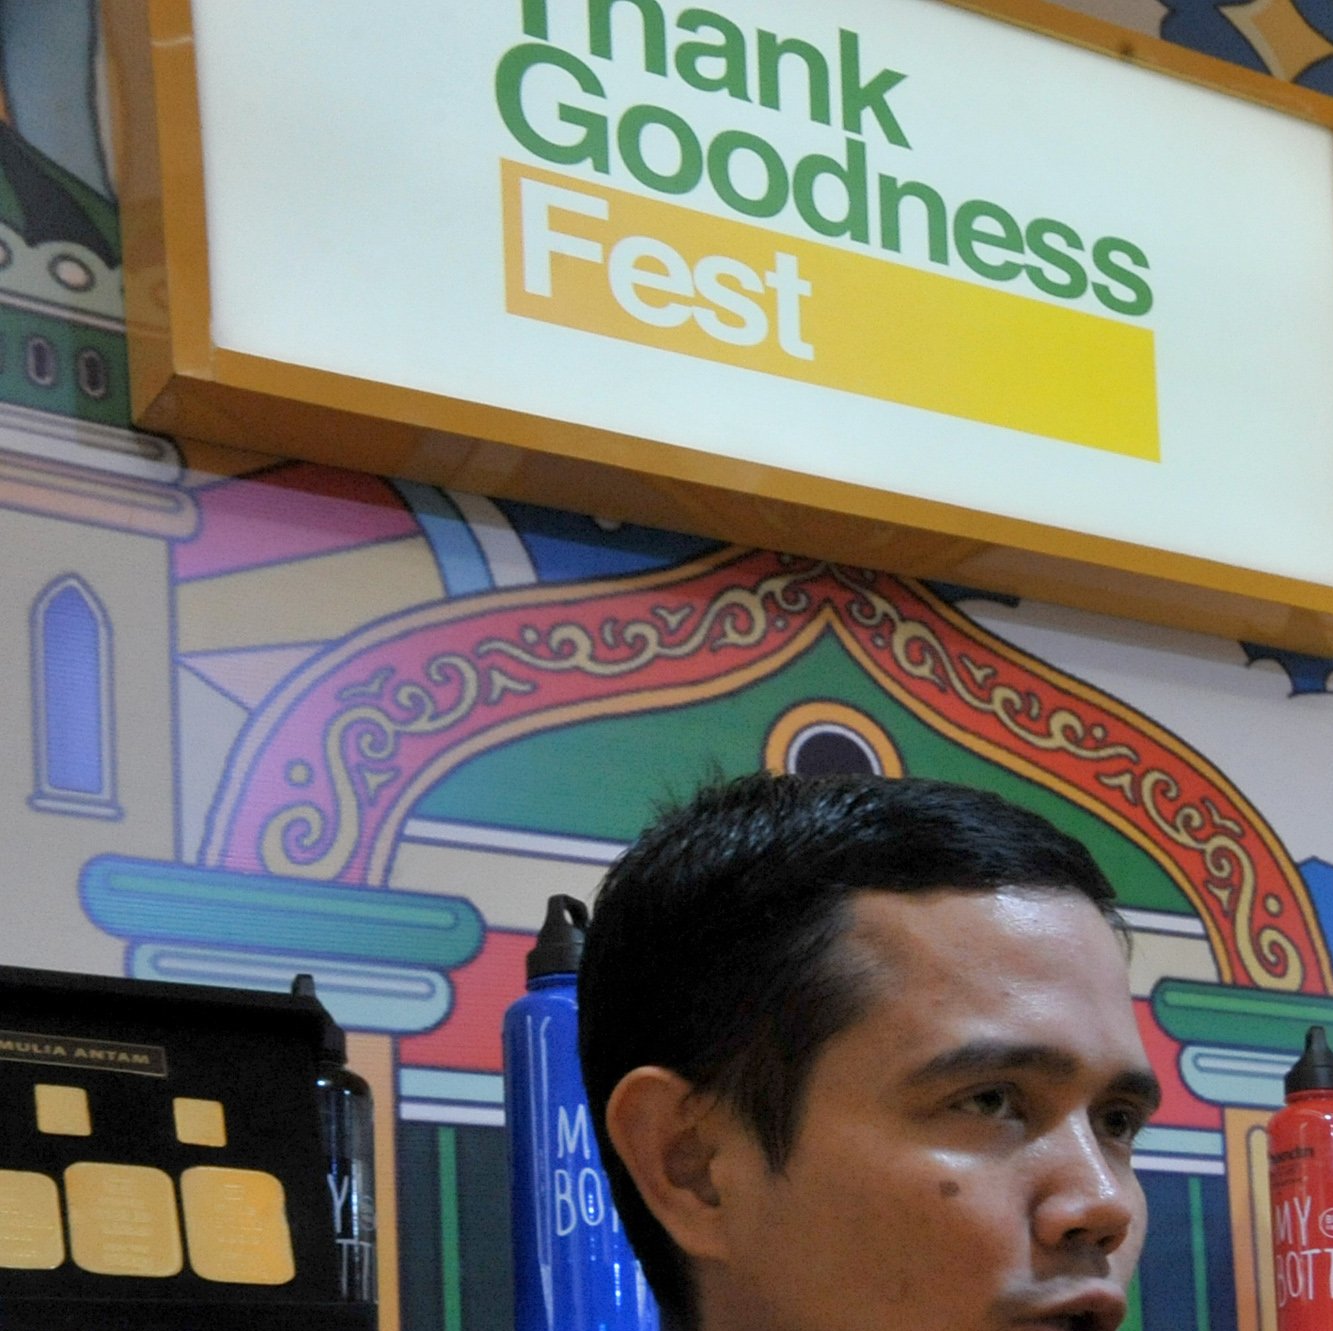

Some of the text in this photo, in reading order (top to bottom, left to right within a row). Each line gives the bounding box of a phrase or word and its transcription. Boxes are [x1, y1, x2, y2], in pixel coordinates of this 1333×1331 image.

[495, 42, 1154, 317] Goodness
[519, 177, 816, 362] Fest
[74, 1047, 150, 1066] ANTAM
[557, 1104, 590, 1160] M
[1275, 1195, 1312, 1246] MY
